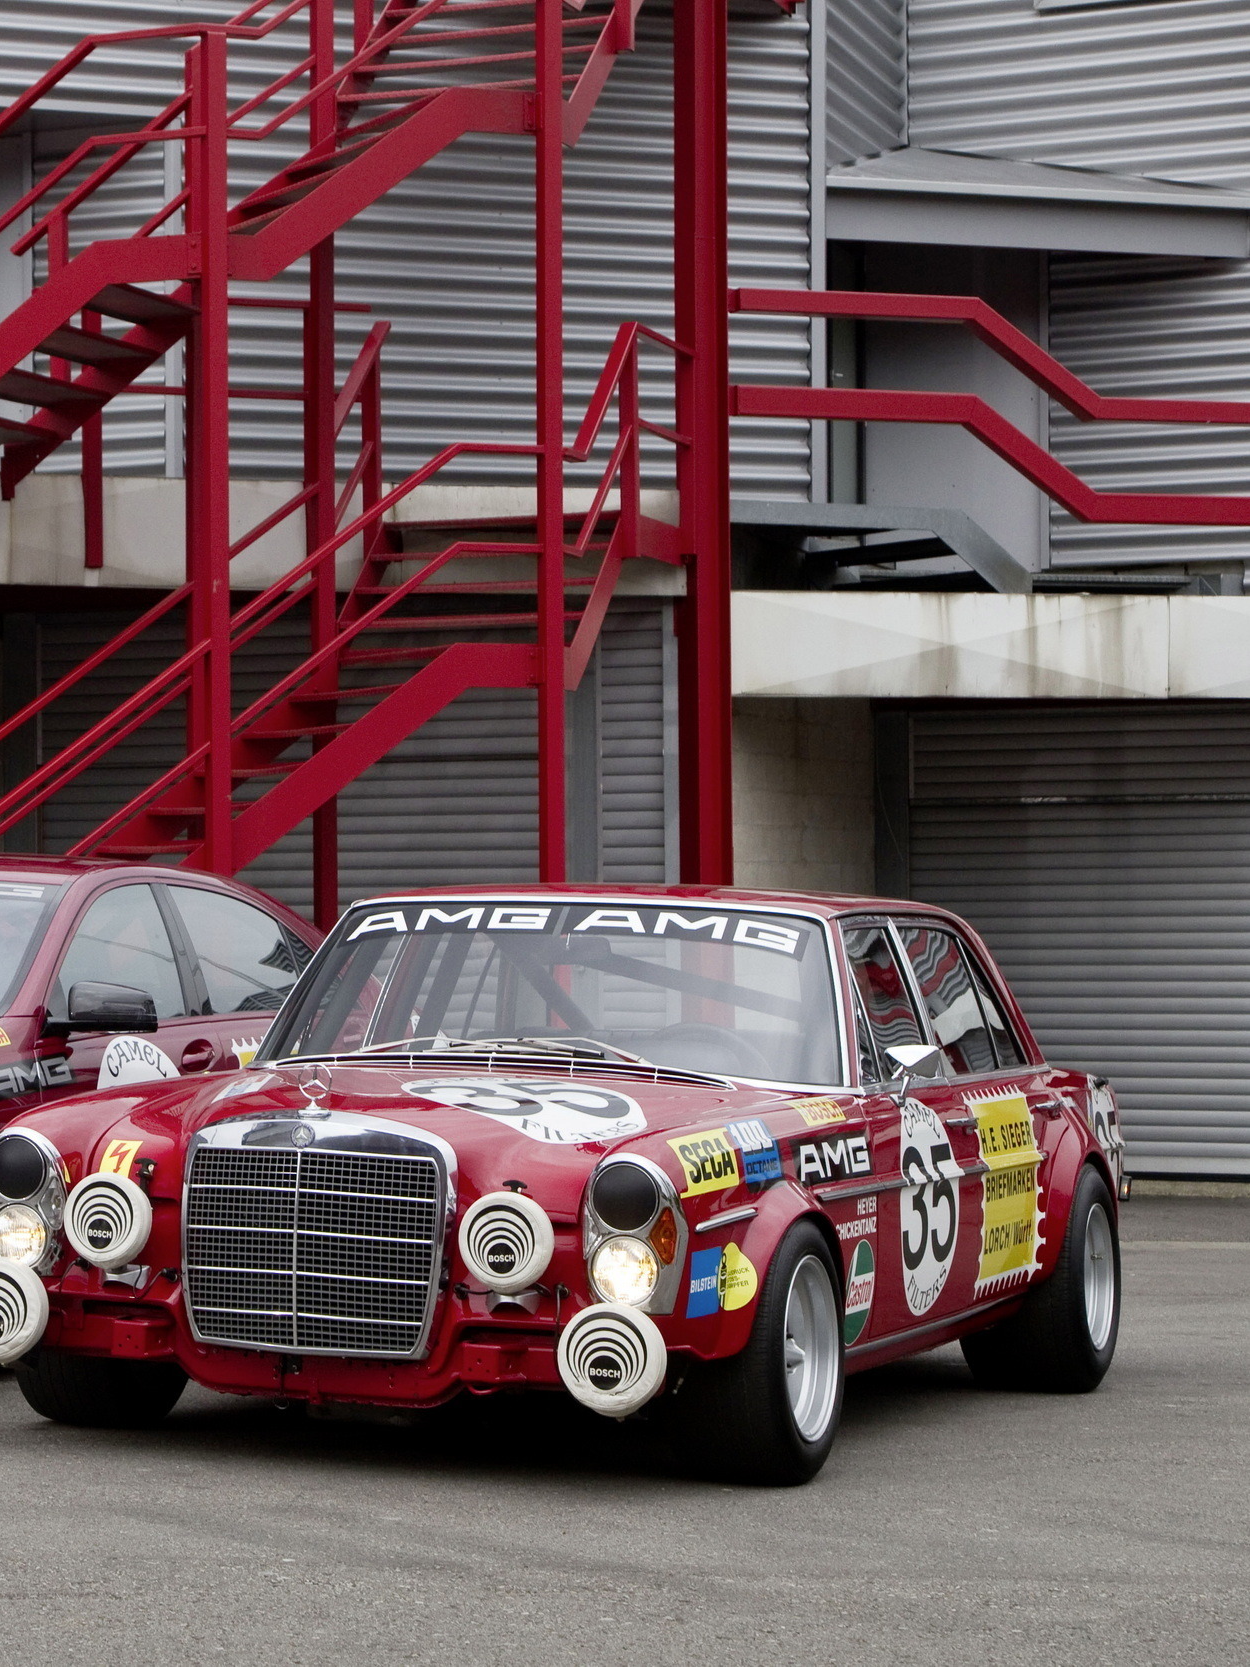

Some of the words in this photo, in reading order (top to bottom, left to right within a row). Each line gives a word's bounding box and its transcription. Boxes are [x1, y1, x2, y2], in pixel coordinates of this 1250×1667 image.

[347, 908, 552, 941] AMG
[573, 909, 801, 957] AMG
[106, 1040, 167, 1079] CAMEL
[409, 1081, 631, 1119] 35
[521, 1118, 640, 1142] FILTERS
[728, 1120, 774, 1152] 100
[904, 1103, 941, 1139] CAMEL
[980, 1126, 1001, 1154] H.E.
[1000, 1120, 1033, 1151] SIEGER
[678, 1137, 736, 1185] SECA
[745, 1157, 779, 1176] OCTANE
[801, 1136, 871, 1182] AMG
[986, 1166, 1035, 1203] BRIEFMARKEN
[857, 1196, 877, 1216] HEYER
[902, 1143, 957, 1271] 35
[88, 1229, 112, 1239] BOSCH
[488, 1254, 515, 1263] BOSCH
[690, 1275, 717, 1294] BILSTEIN
[846, 1275, 874, 1309] Castrol
[907, 1265, 947, 1311] FILTERS
[589, 1367, 621, 1379] BOSCH
